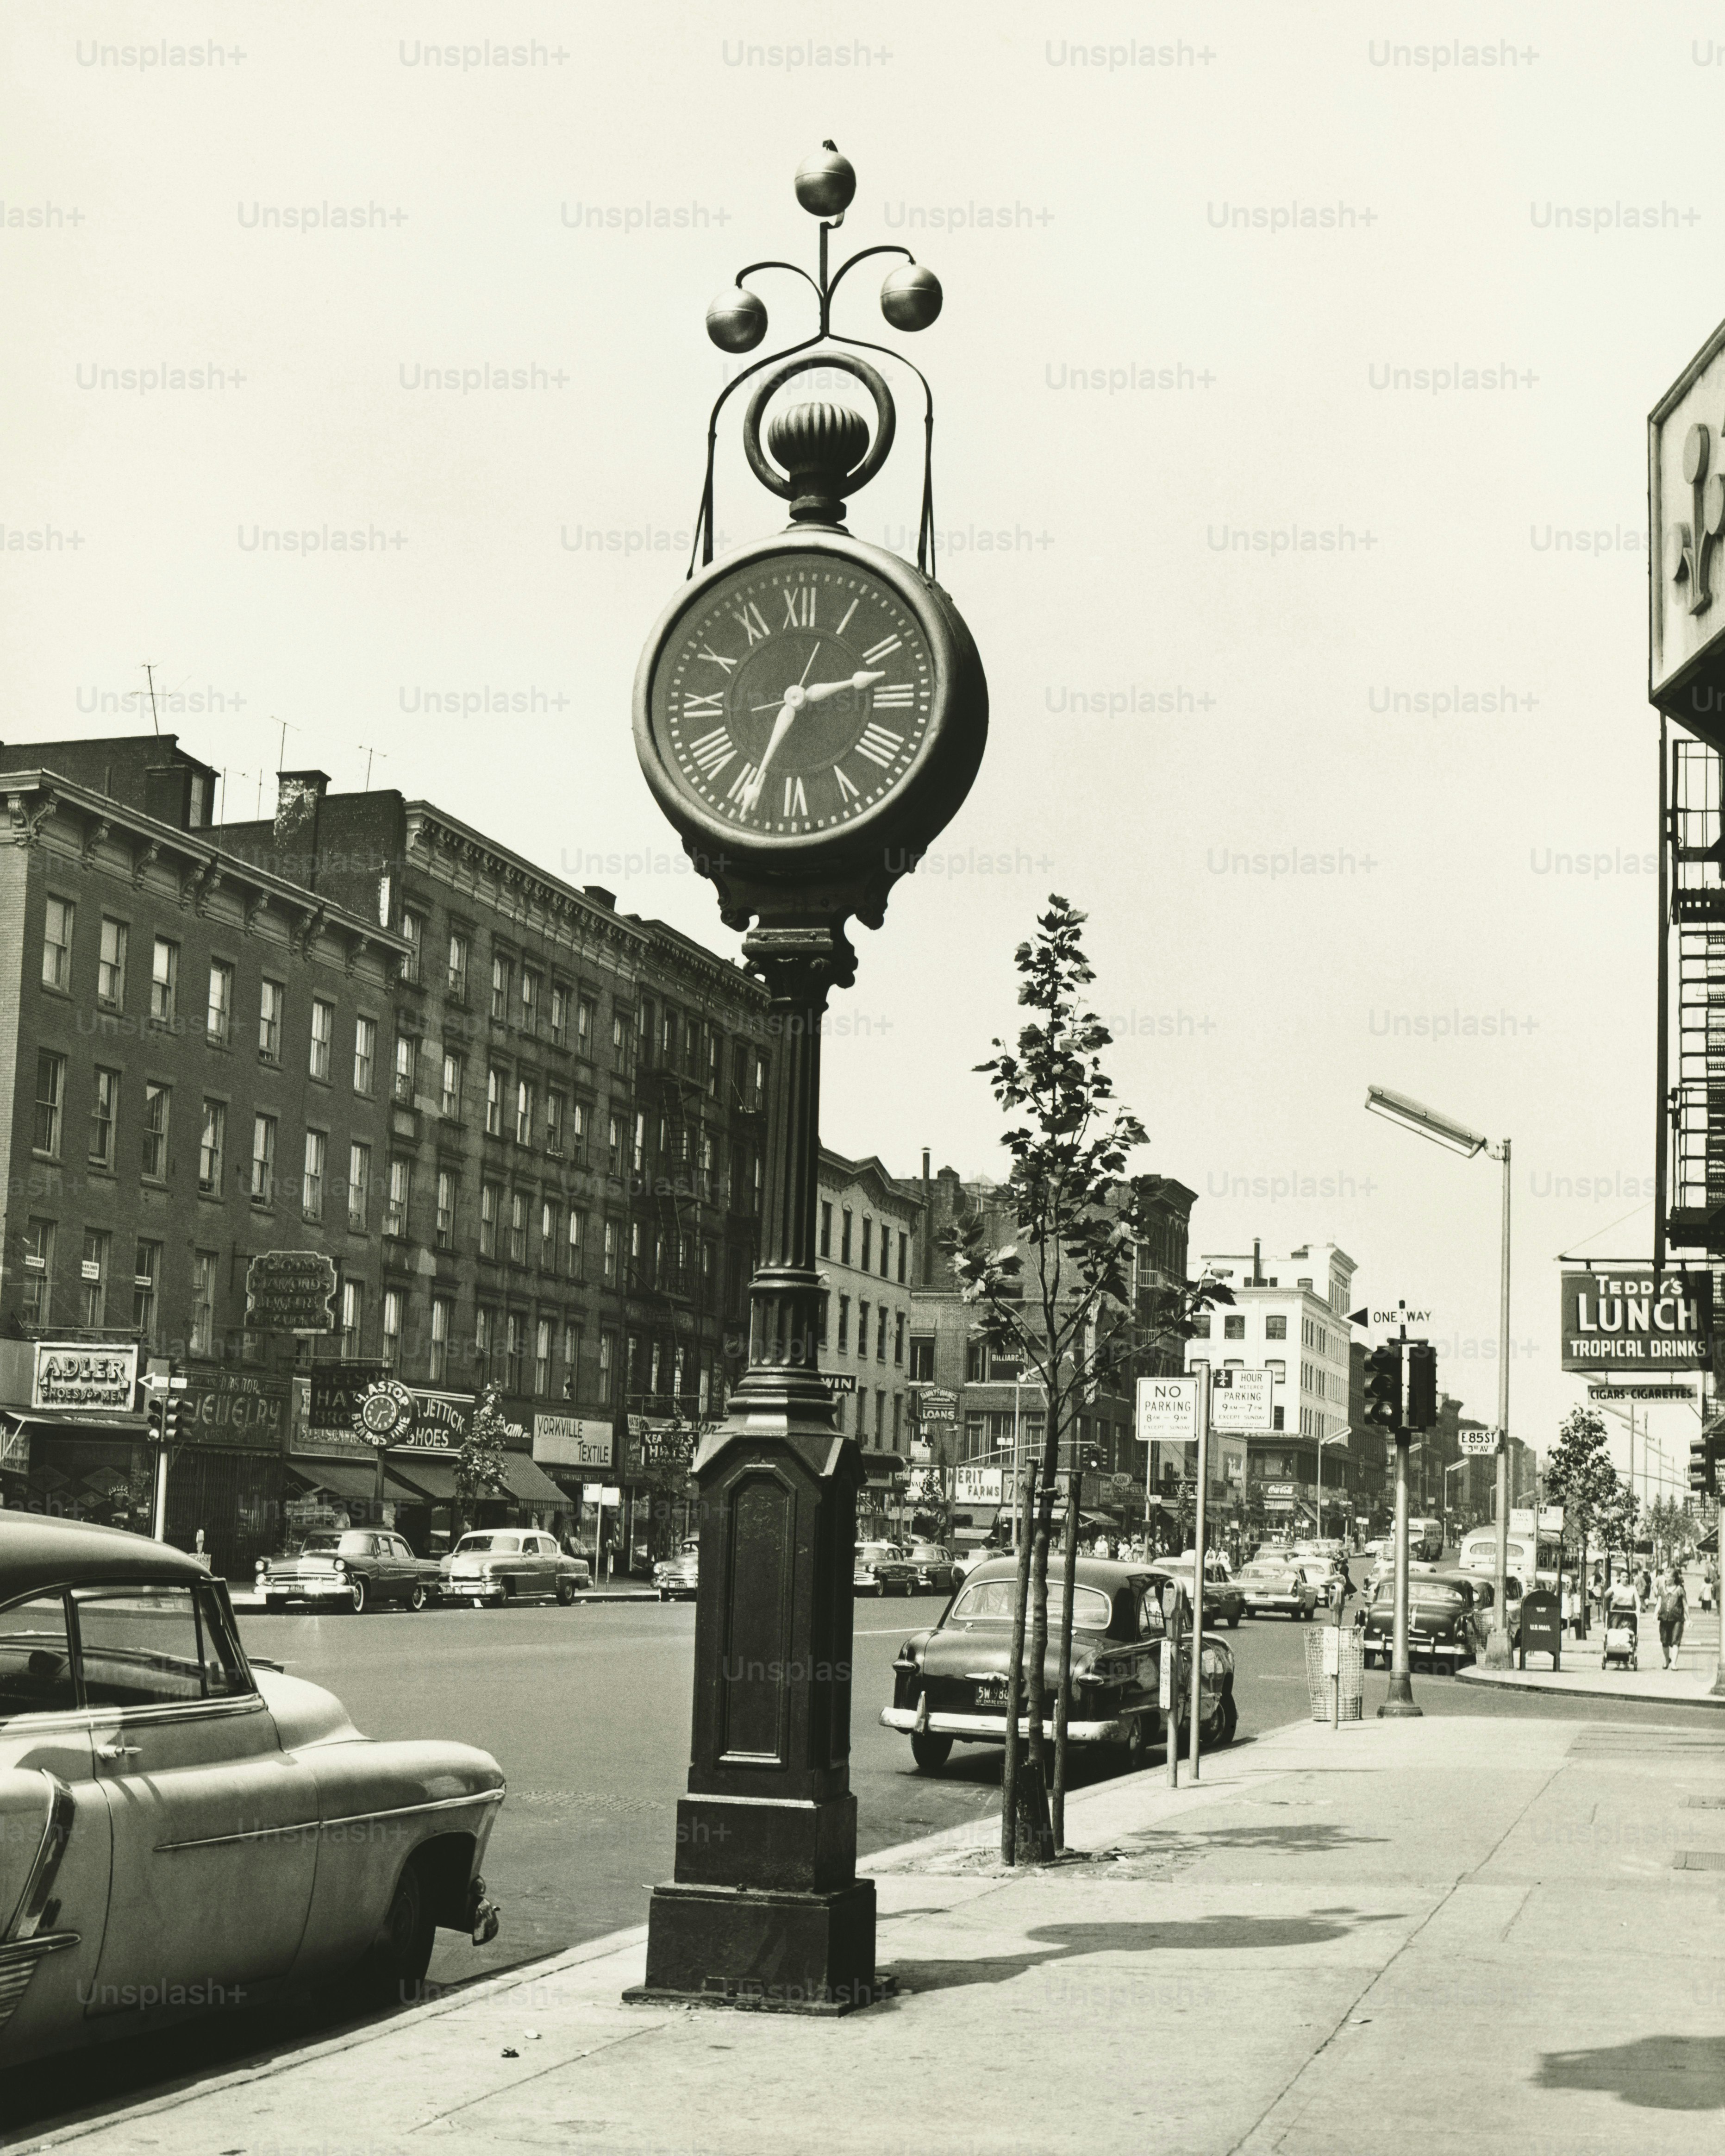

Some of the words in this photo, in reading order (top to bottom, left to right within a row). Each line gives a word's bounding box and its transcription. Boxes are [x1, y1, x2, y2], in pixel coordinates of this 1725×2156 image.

[873, 684, 914, 708] III
[1374, 1311, 1398, 1323] ONE
[1406, 1311, 1431, 1322] WAY
[1576, 1293, 1698, 1334] LUNCH
[1570, 1340, 1645, 1357] TROPICAL
[1650, 1340, 1706, 1357] DRINKS
[39, 1357, 129, 1388] ADLER
[1241, 1373, 1262, 1382] HOUR
[41, 1387, 80, 1399] SHOES
[101, 1390, 125, 1401] MEN
[369, 1381, 409, 1405] ASTOR
[1155, 1385, 1181, 1398] NO
[1224, 1392, 1262, 1401] PARKING
[1590, 1389, 1625, 1399] CIGARS
[1630, 1388, 1693, 1399] CIGARETTES
[192, 1392, 281, 1430] JEWELRY
[1145, 1401, 1191, 1411] PARKING
[423, 1398, 465, 1434] JETTICK
[923, 1410, 955, 1420] LOANS
[351, 1413, 387, 1445] BENRUS
[391, 1416, 411, 1439] TIME
[406, 1427, 449, 1443] SHOES
[538, 1416, 582, 1438] YORKVILLE
[578, 1440, 609, 1463] TEXTILE
[969, 1485, 1000, 1497] FARMS
